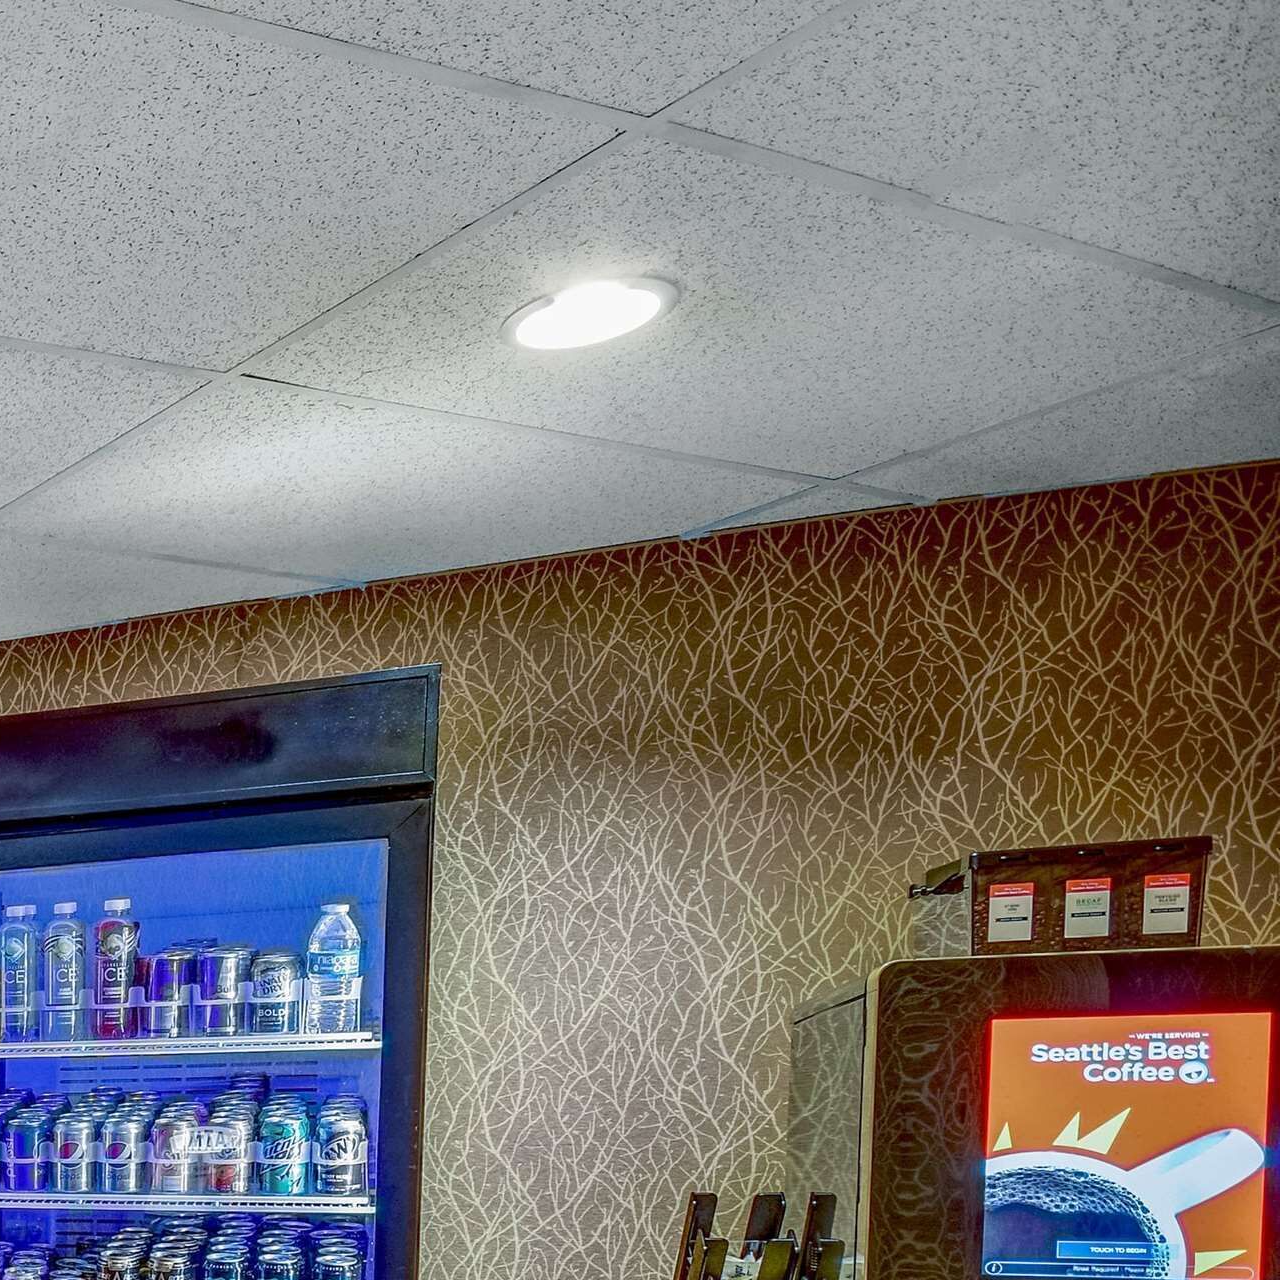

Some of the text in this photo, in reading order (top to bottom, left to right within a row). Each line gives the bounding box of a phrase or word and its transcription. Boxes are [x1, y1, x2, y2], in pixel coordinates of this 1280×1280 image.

[258, 1008, 285, 1016] BOLD
[1031, 1041, 1209, 1062] Seattle's Best
[1083, 1062, 1175, 1082] Coffee
